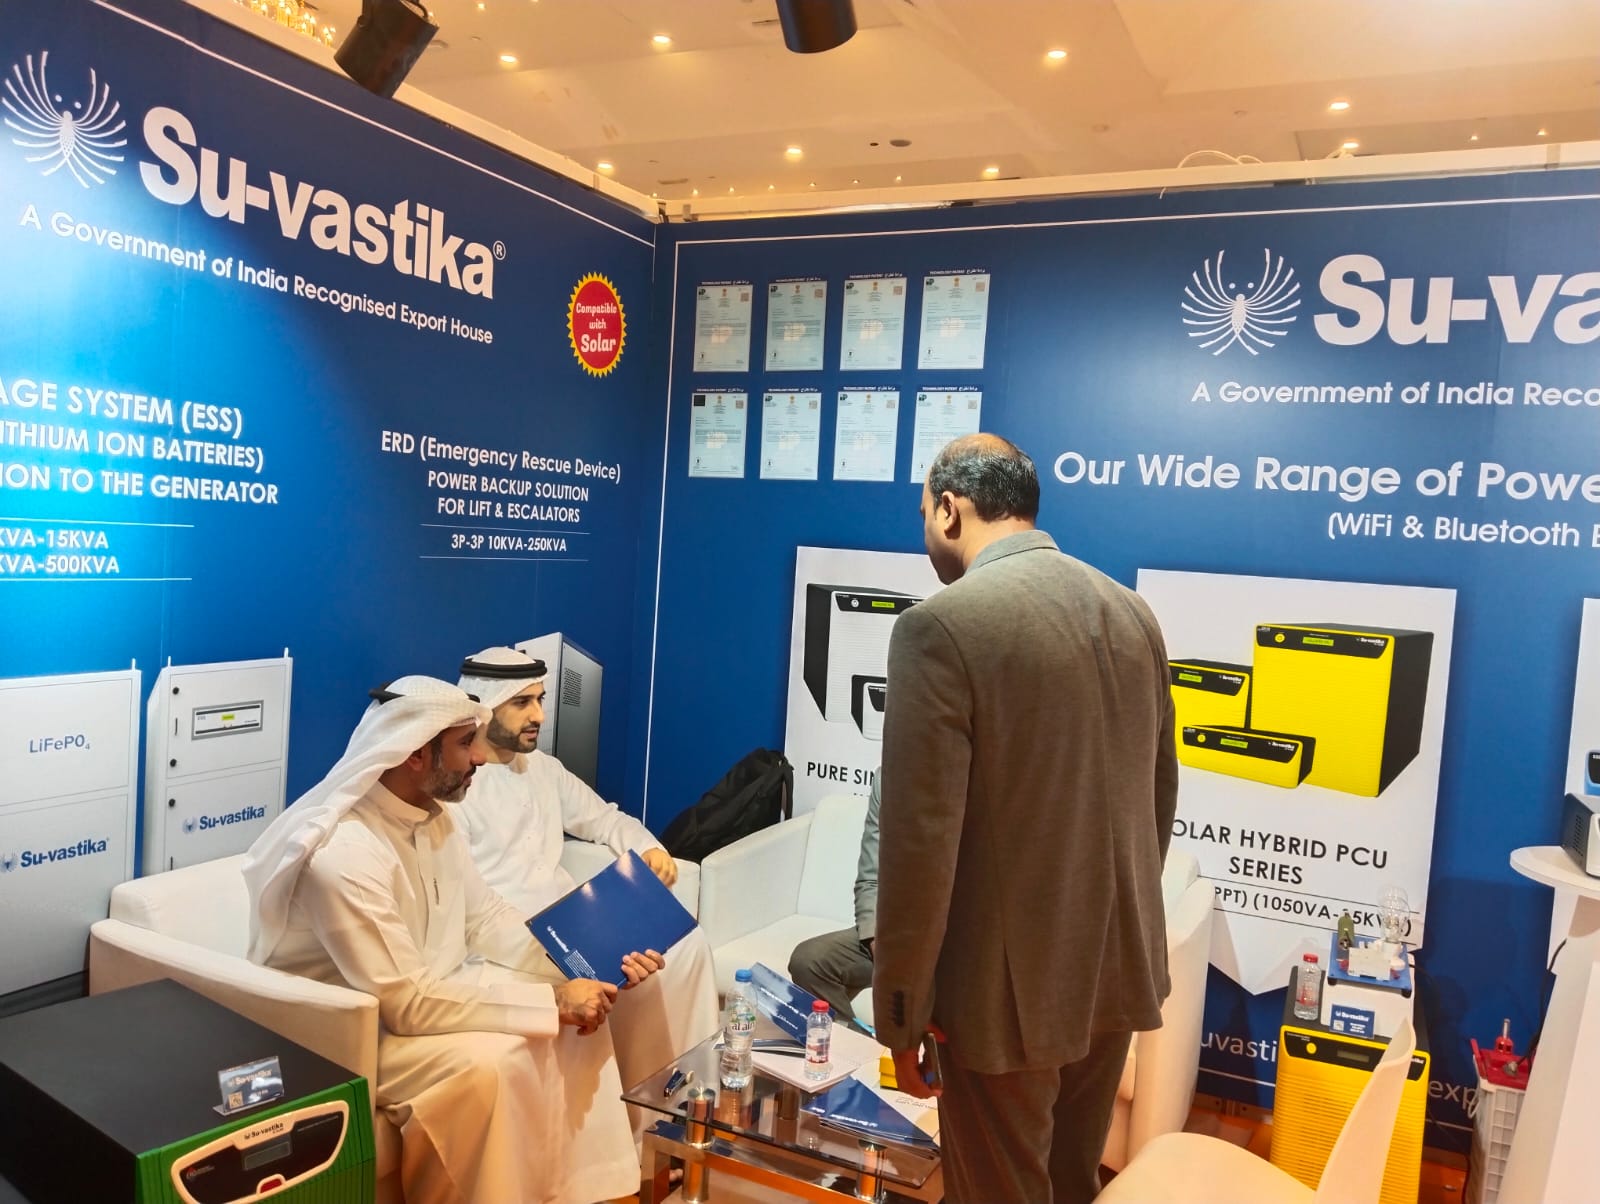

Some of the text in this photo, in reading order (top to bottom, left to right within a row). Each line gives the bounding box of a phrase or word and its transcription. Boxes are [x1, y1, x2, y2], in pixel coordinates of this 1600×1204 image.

[20, 204, 493, 344] A Government of India Recognised Export House
[576, 302, 617, 317] Compatible
[1313, 253, 1600, 346] Su-va
[589, 318, 607, 330] with
[581, 332, 616, 353] Solar
[1191, 381, 1600, 407] A Government of India Reco
[67, 386, 173, 425] SYSTEM
[181, 400, 243, 439] (ESS)
[98, 431, 144, 458] ION
[153, 437, 264, 474] BATTERIES)
[381, 431, 621, 485] ERD (Emergency Rescue Device)
[60, 468, 93, 493] TO
[102, 471, 143, 496] THE
[151, 475, 278, 504] GENERATOR
[428, 471, 588, 502] POWER BACKUP SOLUTION
[1054, 452, 1600, 502] Our Wide Range of Powe
[438, 497, 580, 523] FOR LIFT & ESCALATORS
[451, 534, 567, 552] 3P-3P 10KVA-250KVA
[1328, 512, 1392, 540] (WiFi
[1402, 515, 1424, 539] &
[1434, 517, 1580, 547] Bluetooth
[807, 762, 847, 782] PURE
[199, 805, 265, 831] Su-vastika
[20, 839, 107, 868] Su-vastika
[1240, 829, 1326, 859] HYBRID
[1336, 844, 1387, 869] PCU
[1228, 856, 1303, 884] SERIES
[1253, 892, 1412, 937] (1050VA-5K)
